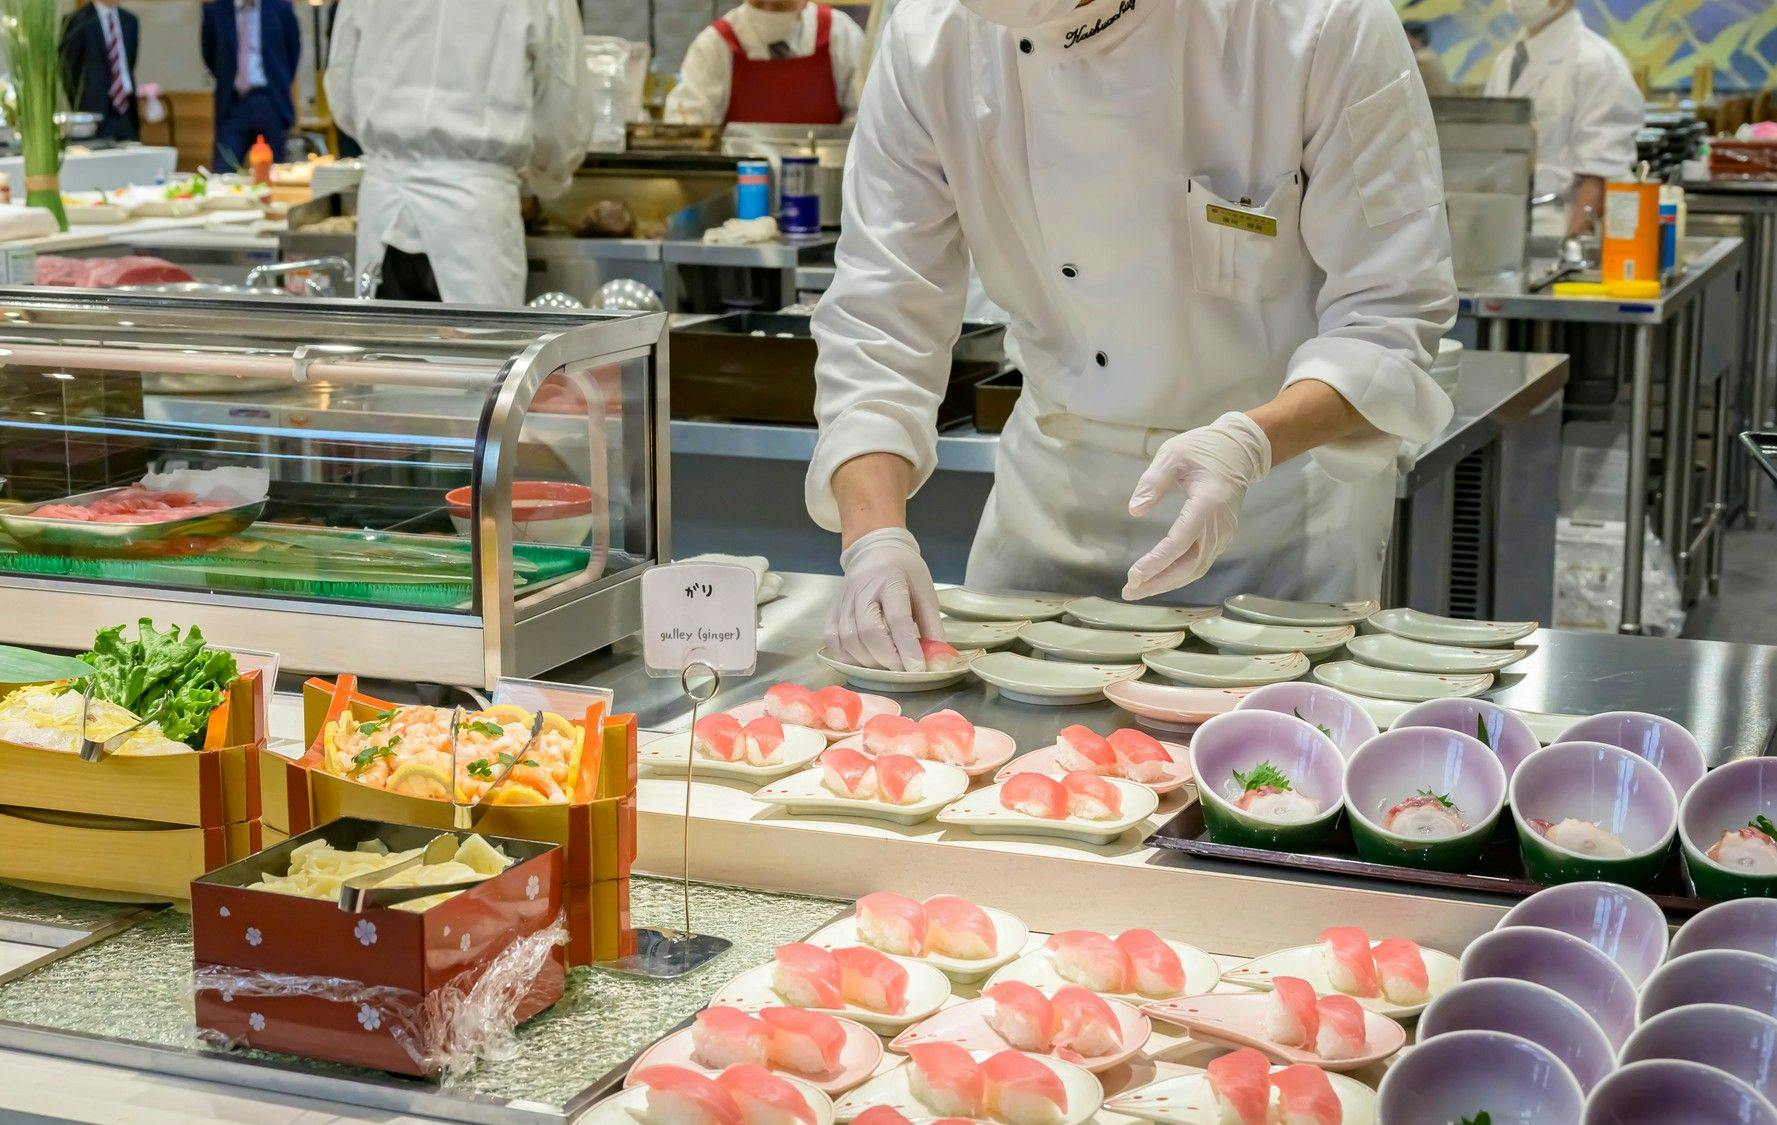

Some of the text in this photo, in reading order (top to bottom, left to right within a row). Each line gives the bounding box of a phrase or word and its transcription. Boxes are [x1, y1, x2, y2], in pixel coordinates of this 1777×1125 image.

[684, 582, 713, 599] がり
[660, 627, 741, 642] gulley (ginger)
